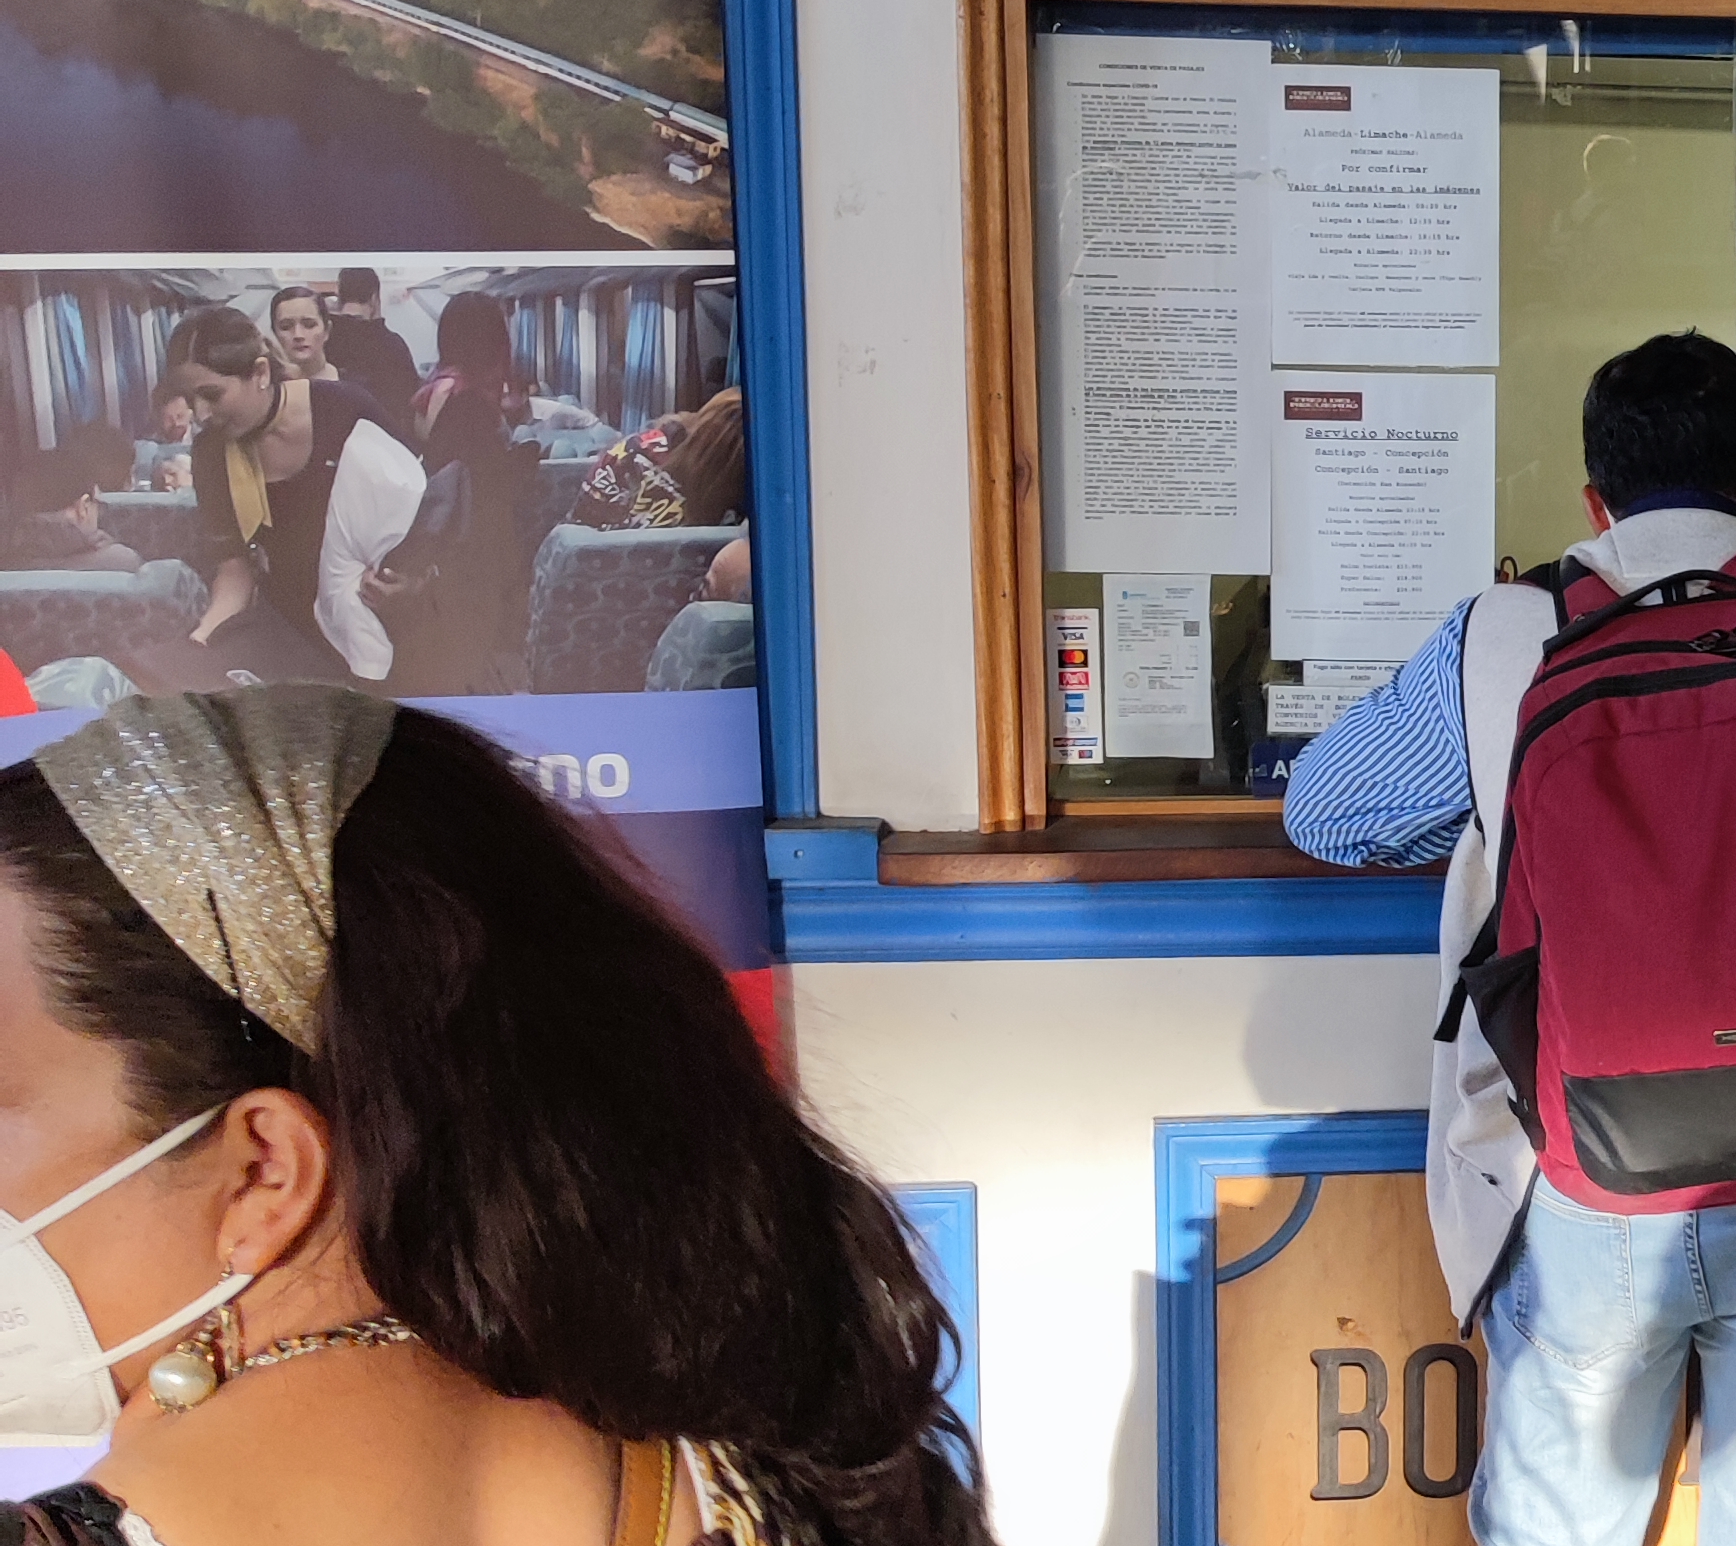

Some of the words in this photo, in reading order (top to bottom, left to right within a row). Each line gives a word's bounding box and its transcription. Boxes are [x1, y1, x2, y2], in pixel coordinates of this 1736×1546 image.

[1341, 165, 1361, 173] Por
[1368, 165, 1428, 174] confirmar
[1287, 183, 1317, 193] Valor
[1325, 183, 1342, 193] del
[1392, 185, 1403, 194] en
[1410, 185, 1427, 194] las
[1305, 427, 1378, 440] Servicio
[1386, 428, 1459, 440] Nocturno
[1315, 448, 1366, 458] Santiago
[1385, 449, 1449, 459] Concepción
[1315, 465, 1378, 475] Concepción
[1398, 466, 1449, 476] Santiago
